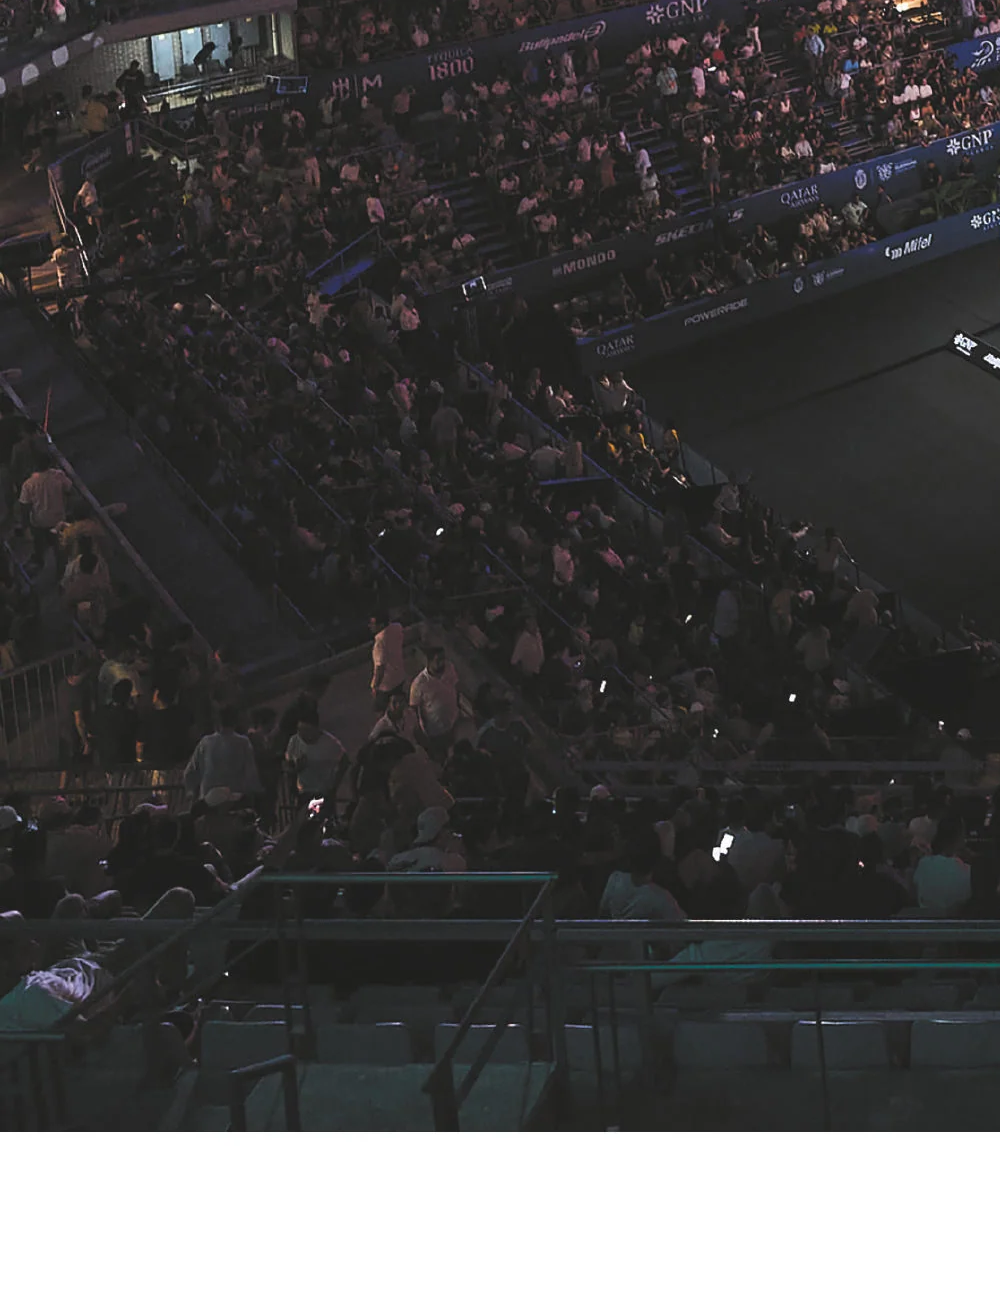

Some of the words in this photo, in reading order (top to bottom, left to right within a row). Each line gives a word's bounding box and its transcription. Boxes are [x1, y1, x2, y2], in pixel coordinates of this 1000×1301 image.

[429, 56, 475, 81] 1800
[961, 129, 993, 151] GNP
[780, 183, 818, 205] QATAR
[903, 233, 932, 255] Mifel
[562, 249, 617, 276] MONDO
[595, 333, 636, 357] QATAR
